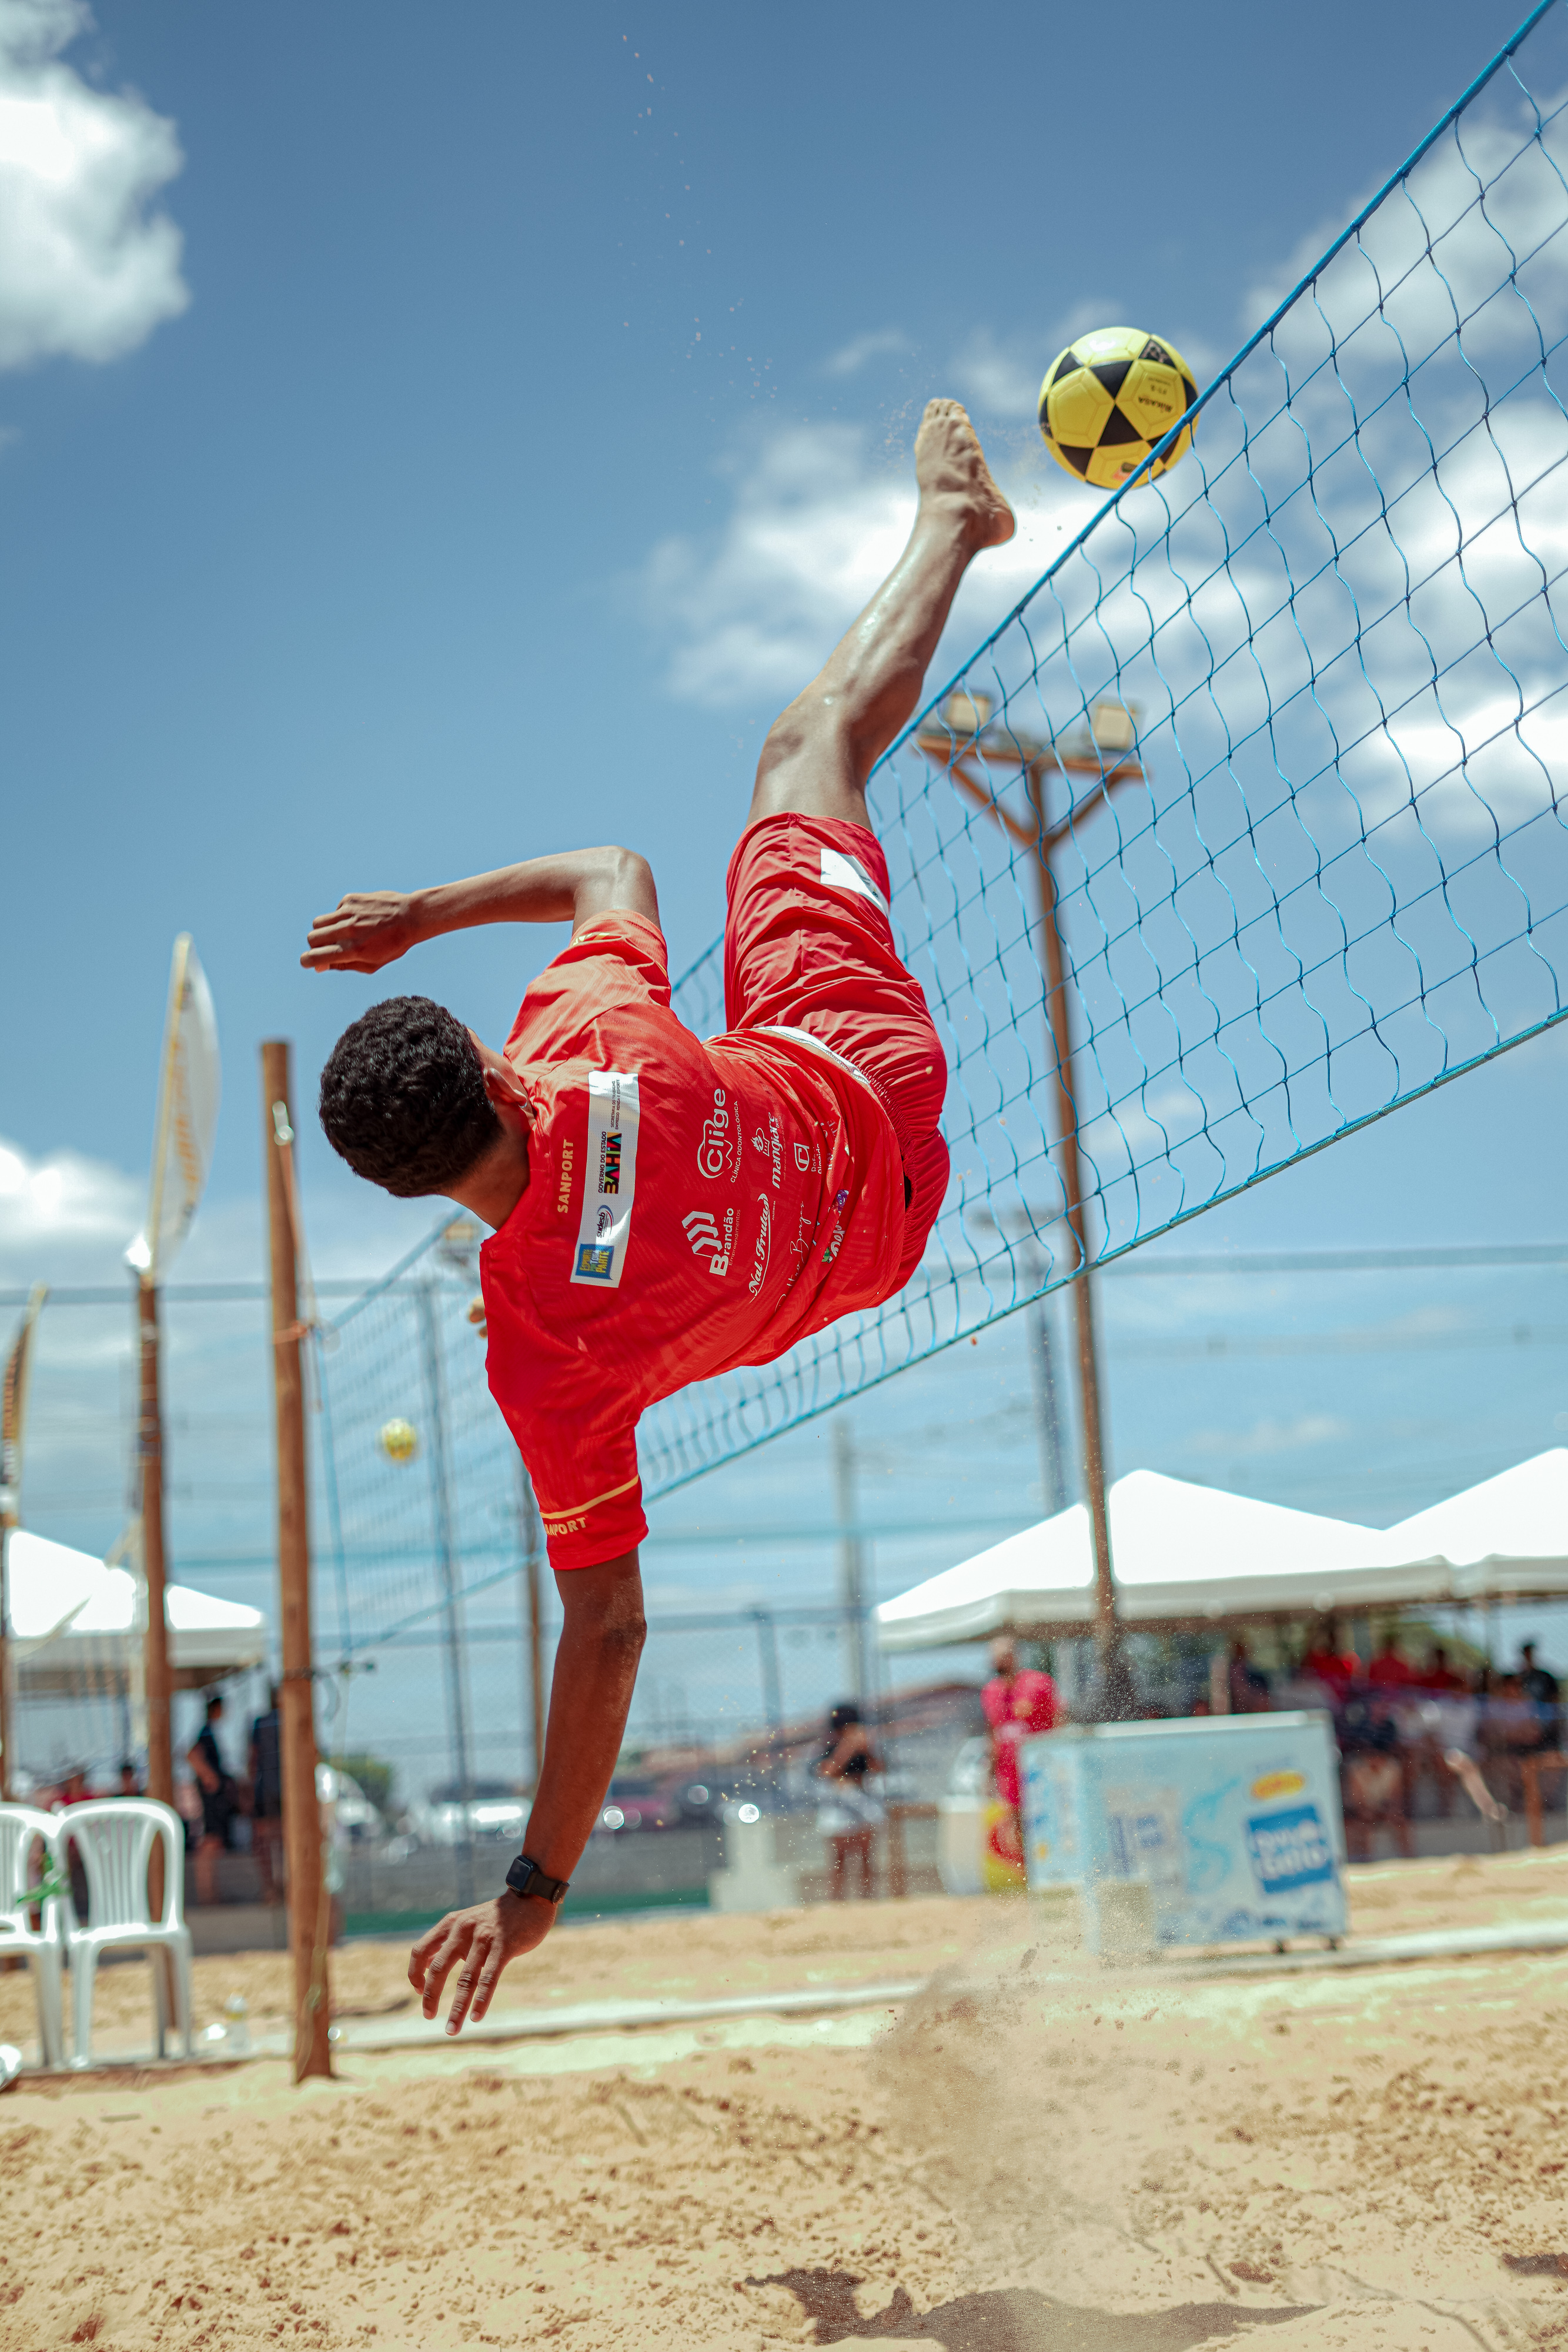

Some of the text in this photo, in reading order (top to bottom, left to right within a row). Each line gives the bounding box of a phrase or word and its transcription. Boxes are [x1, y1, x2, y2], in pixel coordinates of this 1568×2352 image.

[600, 1154, 606, 1164] DO
[707, 1088, 729, 1172] Clige
[730, 1100, 743, 1183] CLÍNICA ODONTOLÓGICA
[768, 1111, 783, 1190] mangiare
[557, 1139, 574, 1214] SANPORT
[597, 1212, 606, 1238] sudesb
[709, 1208, 734, 1277] Brandão
[728, 1209, 741, 1267] Empreendimentos
[748, 1198, 770, 1297] Nal Frutas
[790, 1201, 812, 1264] Borges
